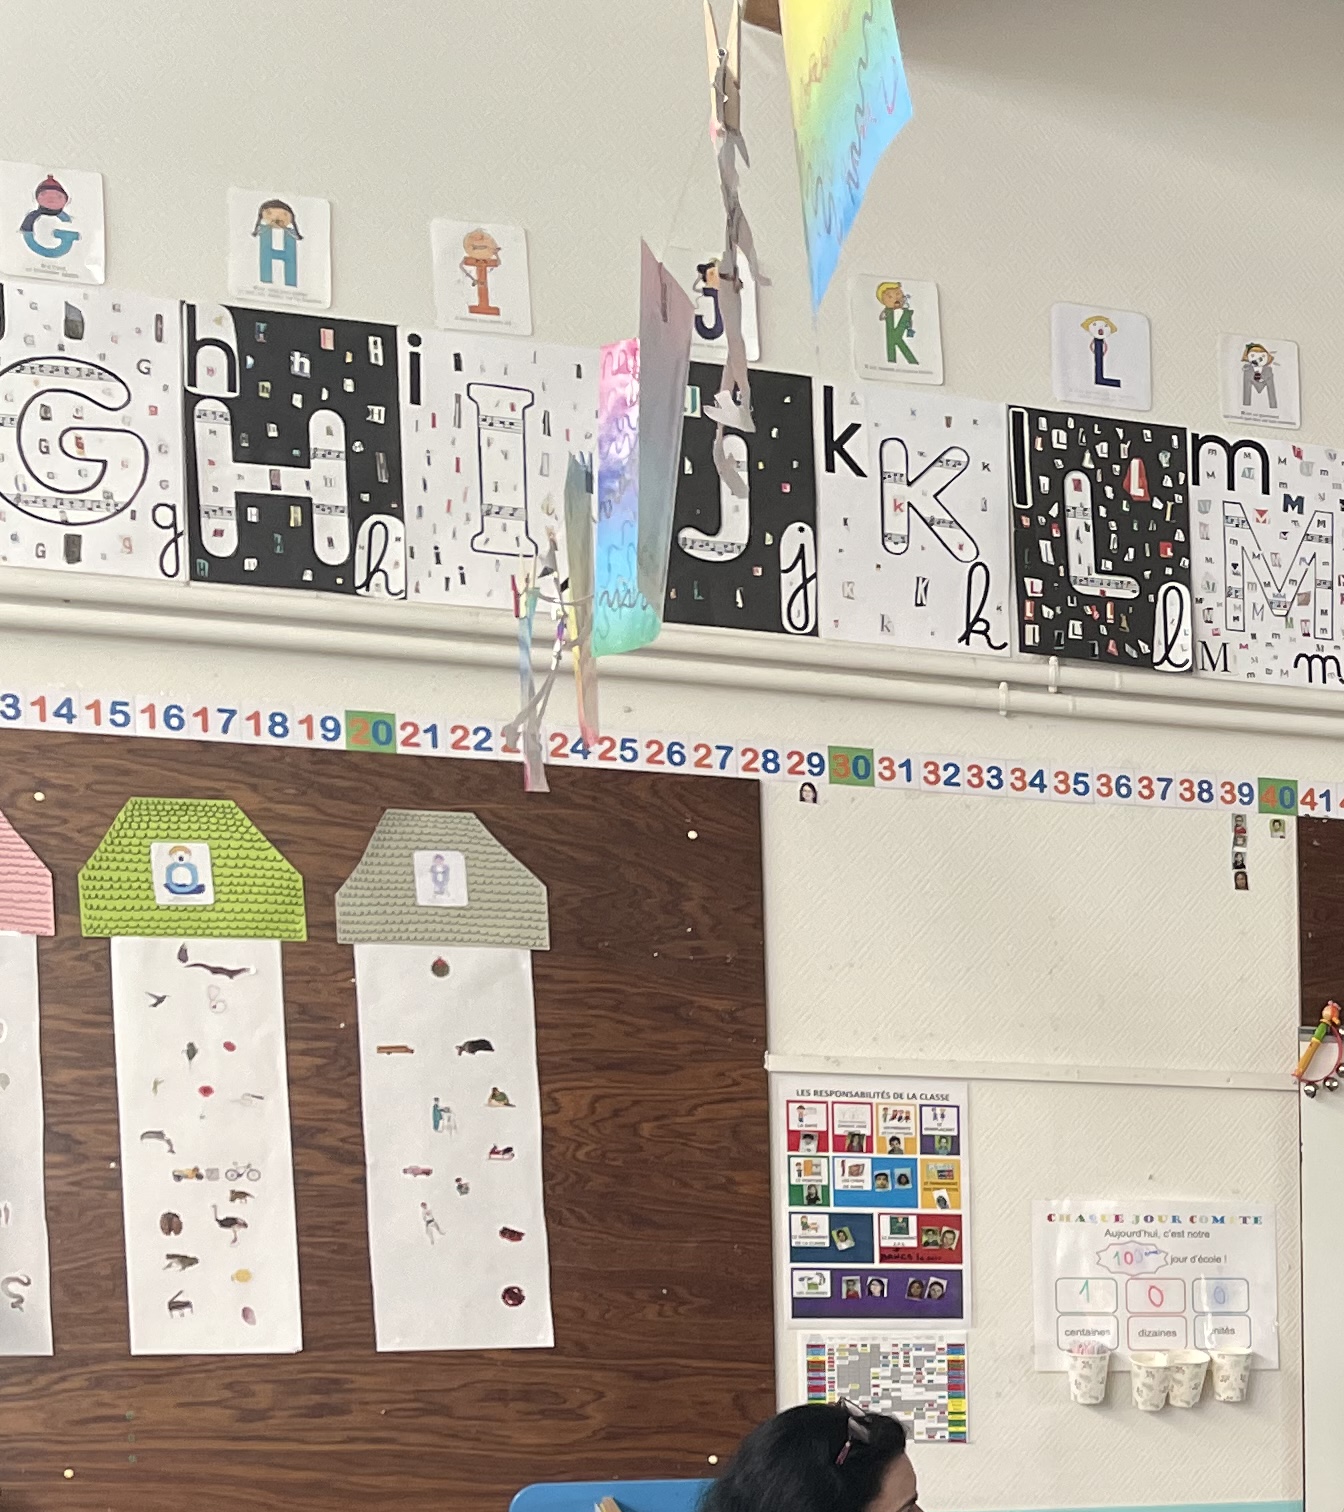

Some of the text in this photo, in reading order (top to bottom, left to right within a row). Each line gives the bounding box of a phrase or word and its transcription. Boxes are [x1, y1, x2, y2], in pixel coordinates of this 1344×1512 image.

[25, 208, 80, 258] G
[259, 228, 298, 287] H
[884, 308, 919, 364] K
[1094, 336, 1121, 388] L
[1242, 365, 1278, 409] M
[30, 696, 76, 725] 14
[86, 700, 130, 728] 15
[140, 704, 185, 732] 16
[193, 707, 237, 734] 17
[246, 711, 290, 738] 18
[299, 715, 342, 742] 19
[350, 719, 393, 747] 20
[400, 722, 438, 748] 21
[450, 725, 492, 752] 22
[596, 736, 638, 763] 25
[645, 739, 686, 766] 26
[694, 743, 733, 770] 27
[741, 747, 780, 775] 28
[787, 750, 825, 777] 29
[833, 754, 871, 780] 30
[877, 756, 913, 783] 31
[922, 761, 961, 788] 32
[966, 764, 1003, 791] 33
[1009, 767, 1047, 794] 34
[1054, 771, 1090, 797] 35
[1096, 773, 1132, 799] 36
[1138, 776, 1173, 802] 37
[1179, 778, 1214, 805] 38
[1220, 781, 1255, 807] 39
[1261, 785, 1296, 810] 40
[1299, 788, 1332, 813] 41
[796, 1088, 811, 1097] LES
[919, 1093, 950, 1101] CLASSE
[1131, 1214, 1183, 1225] JOUR
[1187, 1230, 1210, 1239] notre
[1170, 1255, 1187, 1265] jour
[1138, 1328, 1177, 1337] dizaines
